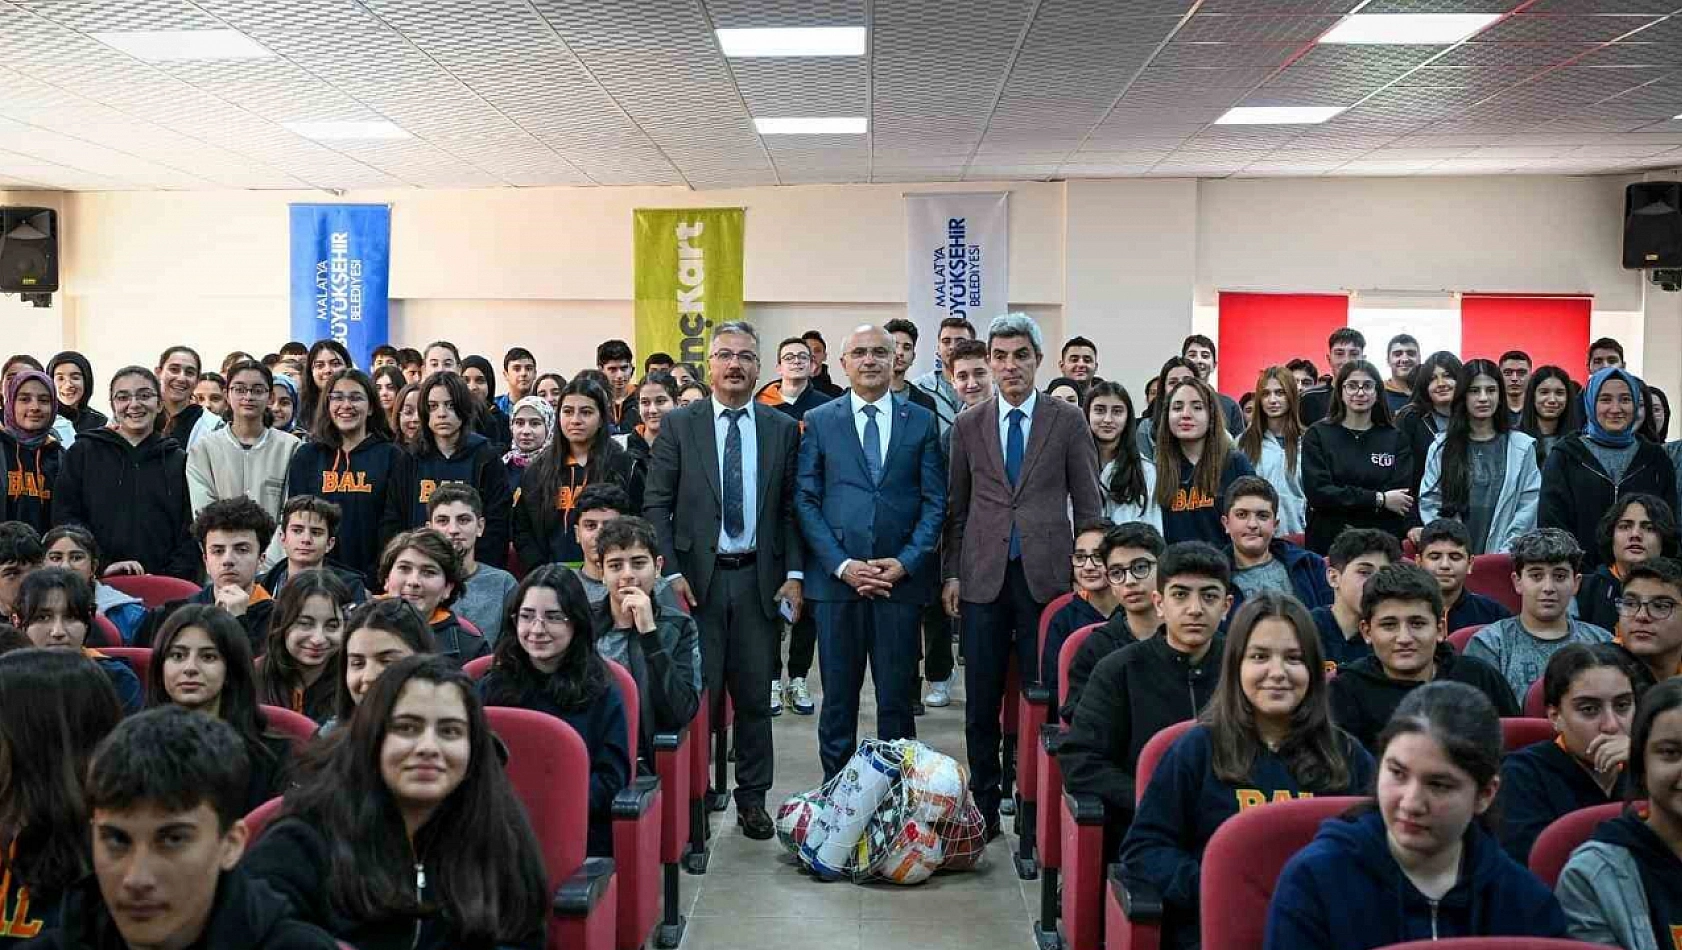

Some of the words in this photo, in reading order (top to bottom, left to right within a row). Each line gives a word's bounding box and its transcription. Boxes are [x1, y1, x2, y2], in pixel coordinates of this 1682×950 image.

[316, 260, 328, 320] MALATYA
[934, 247, 946, 307] MALATYA
[948, 218, 967, 319] ÜYÜKŞEHİR
[675, 222, 713, 381] nçKart
[322, 470, 372, 492] BAL
[1172, 486, 1215, 511] BAL
